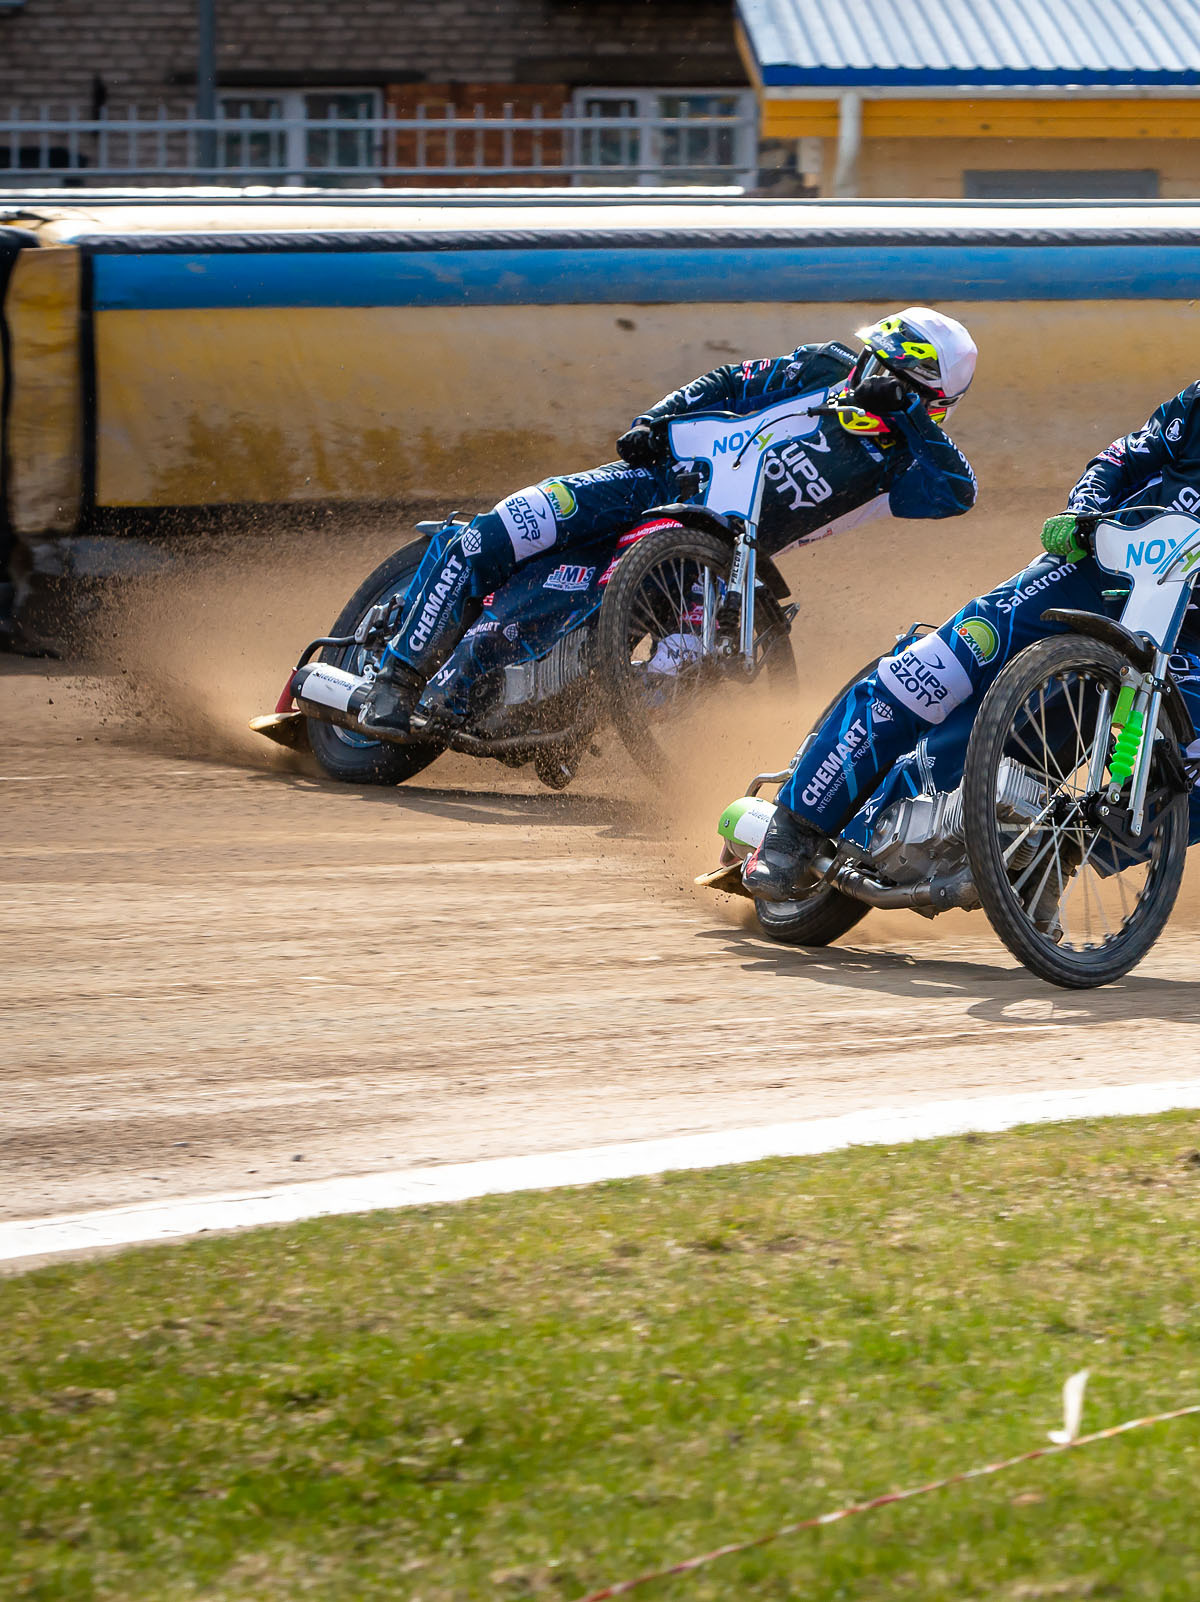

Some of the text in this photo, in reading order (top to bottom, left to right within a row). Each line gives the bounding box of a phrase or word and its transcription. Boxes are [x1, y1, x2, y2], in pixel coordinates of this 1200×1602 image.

[780, 442, 833, 504] UPa
[453, 566, 473, 604] TRADER
[730, 550, 742, 585] FALCON
[995, 562, 1078, 614] Saletrom
[409, 554, 464, 652] CHEMART
[802, 718, 868, 807] CHEMART
[816, 732, 879, 814] INTERNATIONAL TRADER
